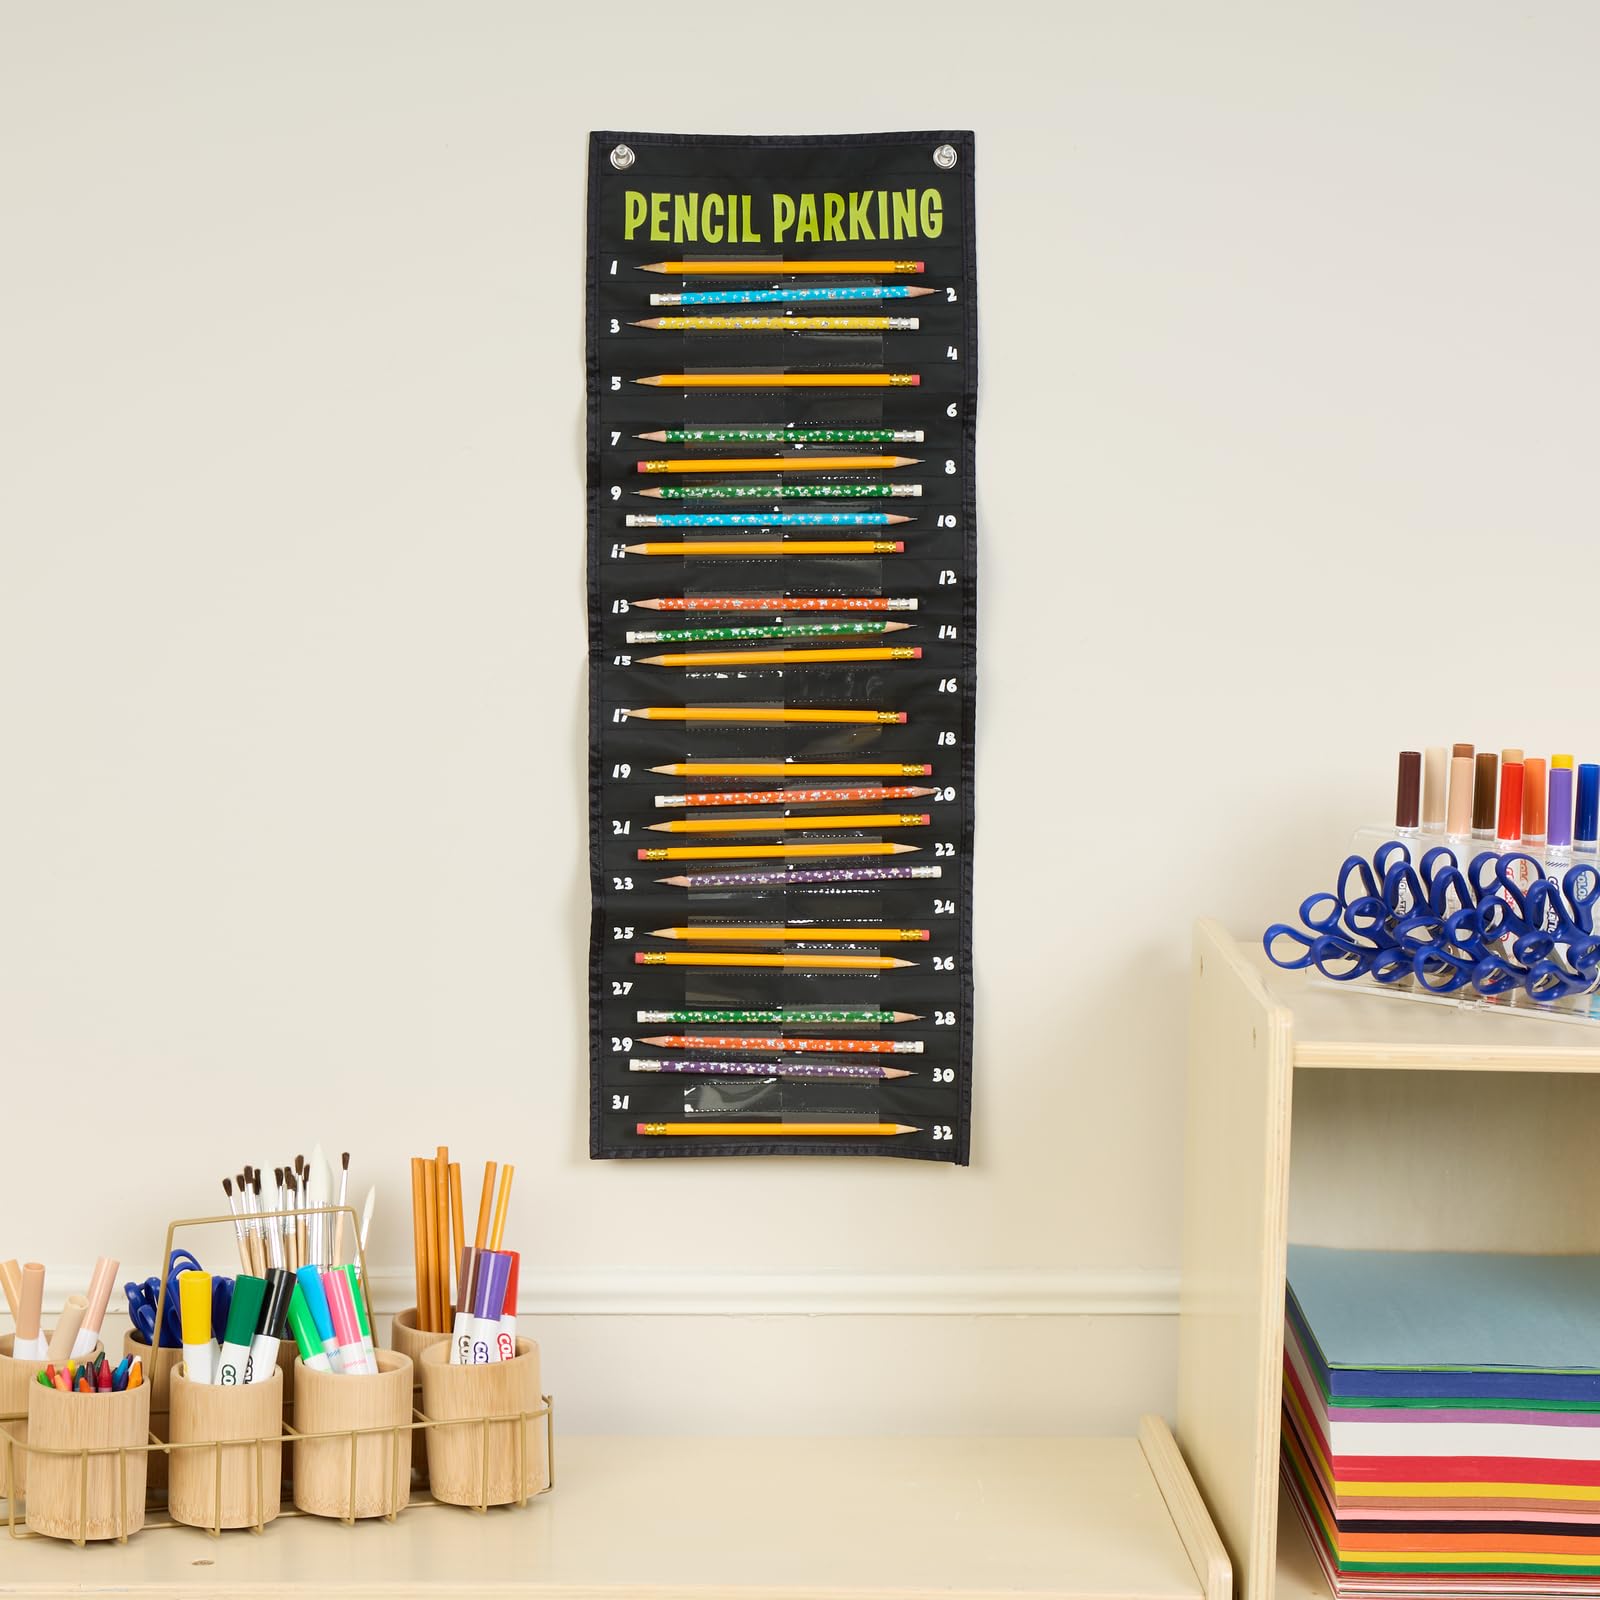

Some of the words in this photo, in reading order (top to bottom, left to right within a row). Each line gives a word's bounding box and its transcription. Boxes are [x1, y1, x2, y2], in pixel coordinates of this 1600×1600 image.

[624, 191, 762, 243] PENCIL
[773, 188, 943, 243] PARKING
[610, 261, 618, 275] 1
[946, 288, 957, 302] 2
[610, 319, 620, 333] 3
[947, 346, 958, 360] 4
[611, 376, 621, 390] 5
[947, 403, 957, 417] 6
[611, 432, 621, 446] 7
[945, 460, 956, 474] 8
[610, 486, 621, 500] 9
[937, 515, 957, 528] 10
[939, 570, 957, 585] 12
[612, 599, 630, 614] 13
[939, 625, 957, 639] 14
[613, 655, 631, 666] 15
[939, 678, 957, 693] 16
[613, 708, 631, 723] 17
[938, 731, 956, 745] 18
[613, 764, 631, 778] 19
[933, 786, 956, 802] 20
[613, 821, 630, 835] 21
[935, 843, 955, 857] 22
[613, 877, 634, 890] 23
[934, 900, 955, 914] 24
[613, 926, 634, 940] 25
[933, 956, 955, 970] 26
[612, 982, 633, 995] 27
[934, 1011, 956, 1025] 28
[612, 1037, 633, 1052] 29
[933, 1068, 955, 1083] 30
[612, 1094, 630, 1109] 31
[933, 1125, 953, 1140] 32
